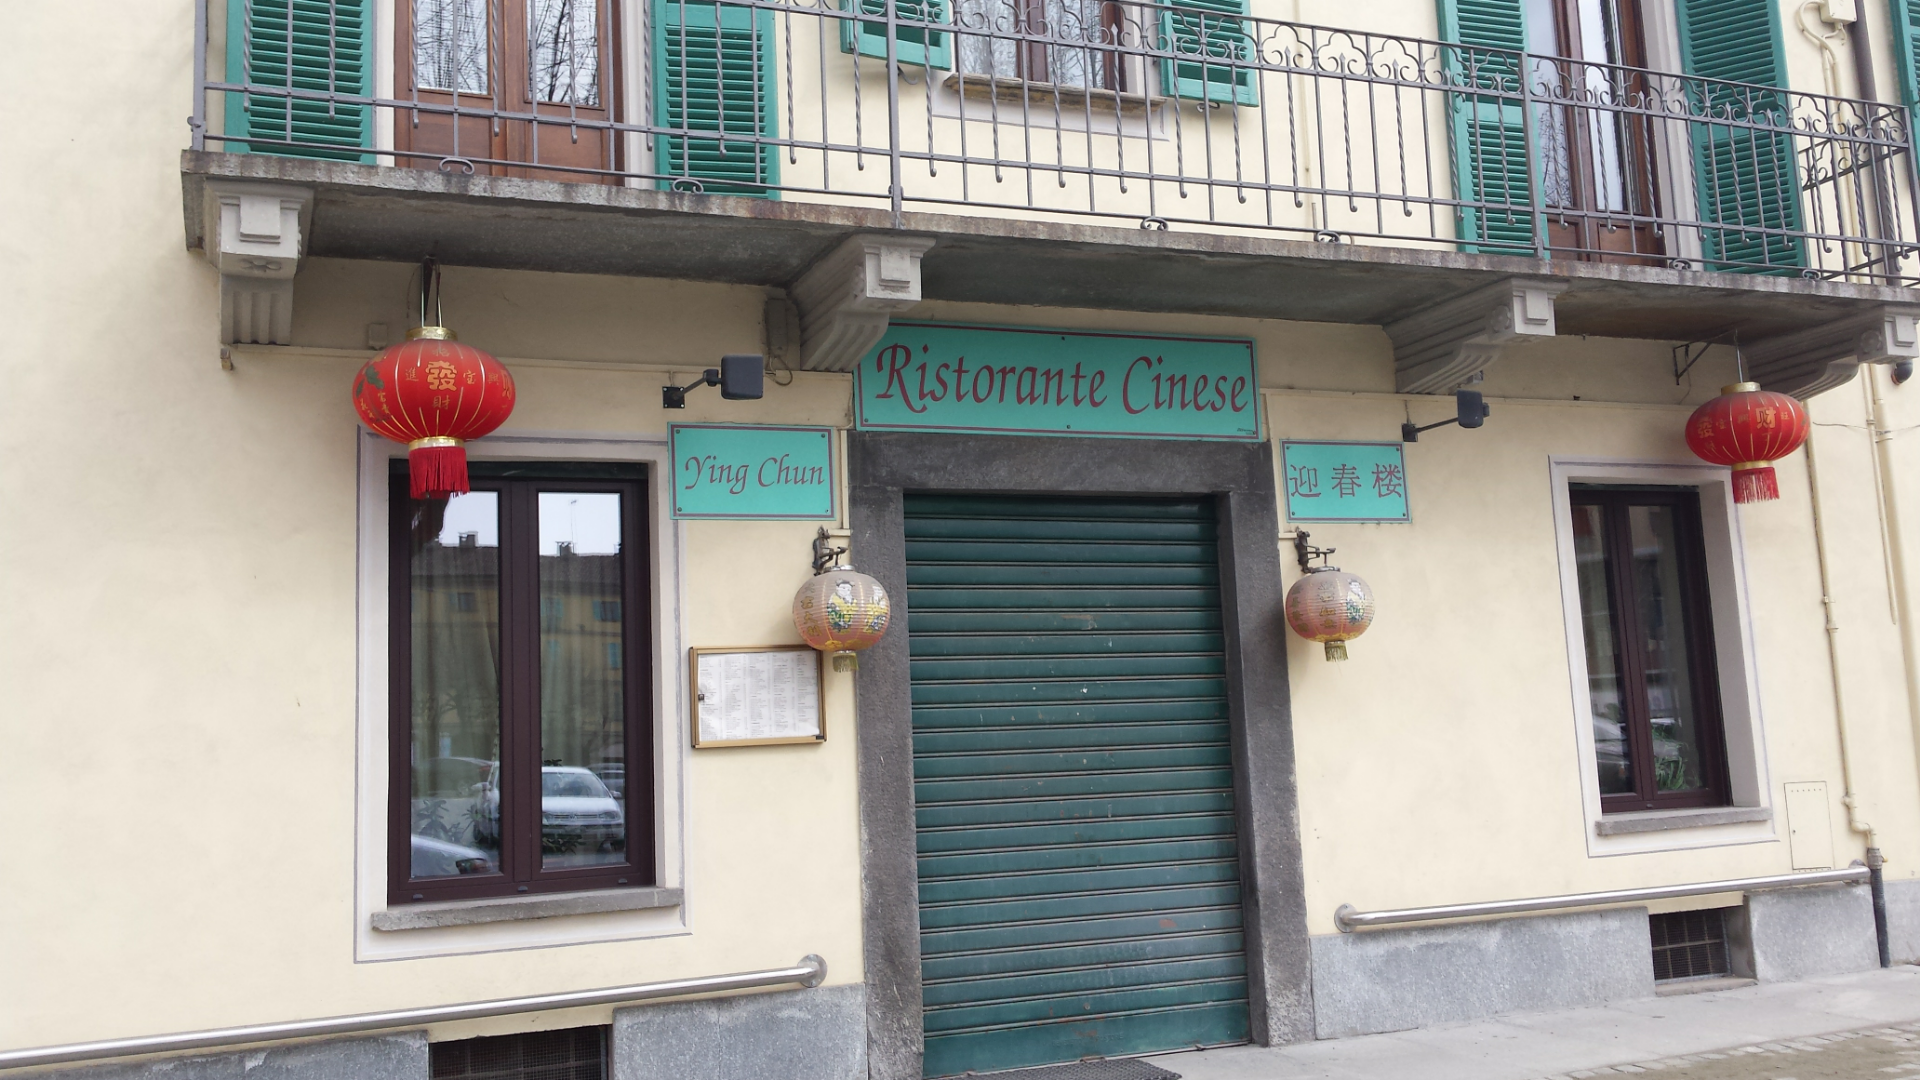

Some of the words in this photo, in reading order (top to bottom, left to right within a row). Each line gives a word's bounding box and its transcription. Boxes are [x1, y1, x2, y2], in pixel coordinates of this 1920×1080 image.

[875, 342, 1108, 414] Ristorante
[1122, 354, 1249, 415] Cinese
[684, 454, 750, 495] Ying
[757, 453, 825, 488] Chun
[1288, 463, 1402, 498] 迎春楼
